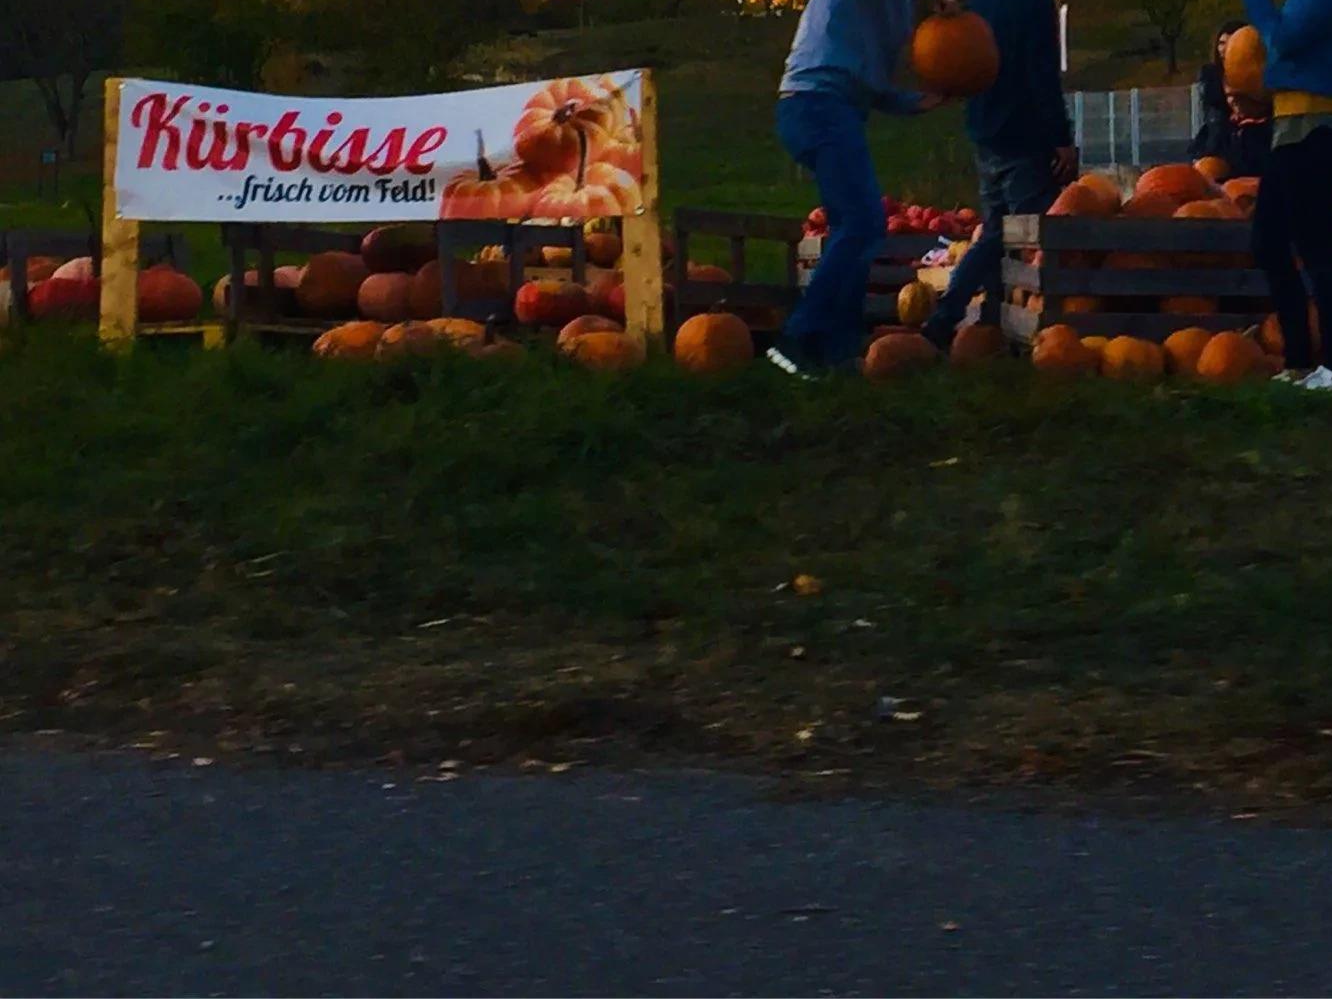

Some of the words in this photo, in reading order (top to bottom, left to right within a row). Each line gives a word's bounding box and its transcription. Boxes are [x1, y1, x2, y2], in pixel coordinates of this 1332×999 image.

[130, 93, 447, 175] Kürbisse
[217, 174, 313, 210] ...frisch
[319, 180, 371, 204] vom
[376, 177, 436, 204] Feld!
